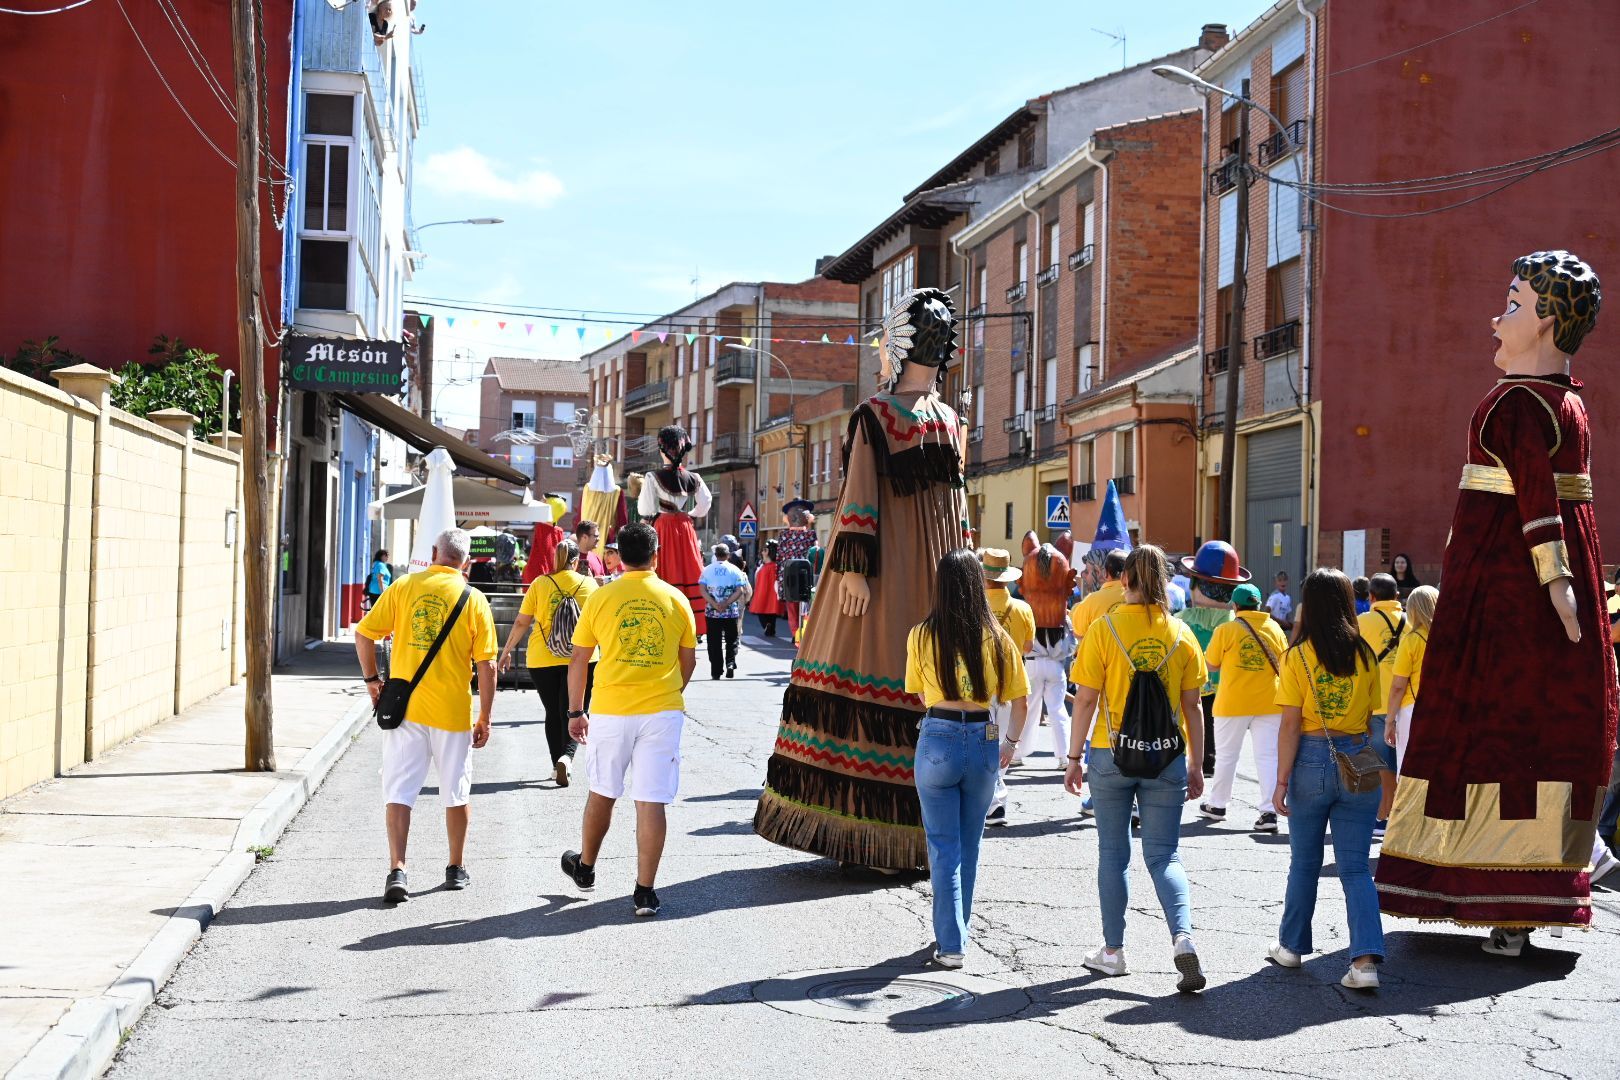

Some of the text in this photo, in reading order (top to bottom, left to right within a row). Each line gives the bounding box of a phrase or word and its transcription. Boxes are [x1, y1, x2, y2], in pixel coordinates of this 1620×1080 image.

[304, 342, 389, 364] Mesón
[292, 365, 400, 385] El Campesino
[1119, 734, 1179, 752] Tuesday
